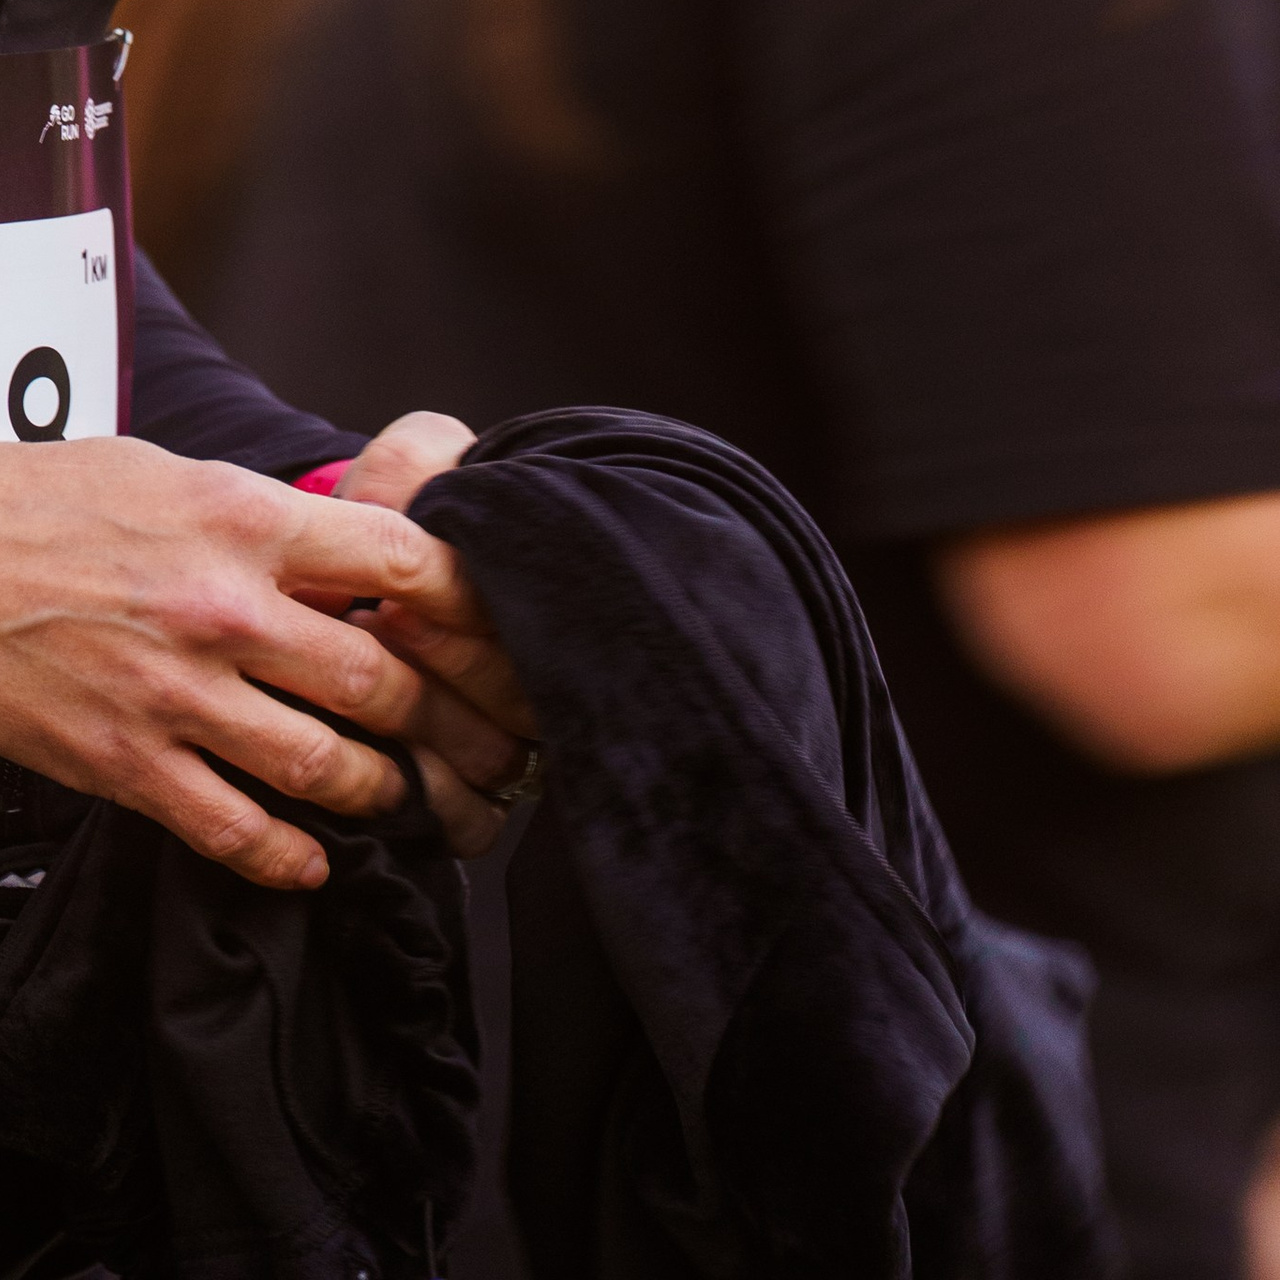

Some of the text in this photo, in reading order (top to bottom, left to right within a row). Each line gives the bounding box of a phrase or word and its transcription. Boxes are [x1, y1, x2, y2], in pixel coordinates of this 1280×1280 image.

[61, 104, 76, 123] GO
[61, 123, 80, 141] RUN
[81, 248, 88, 285] 1
